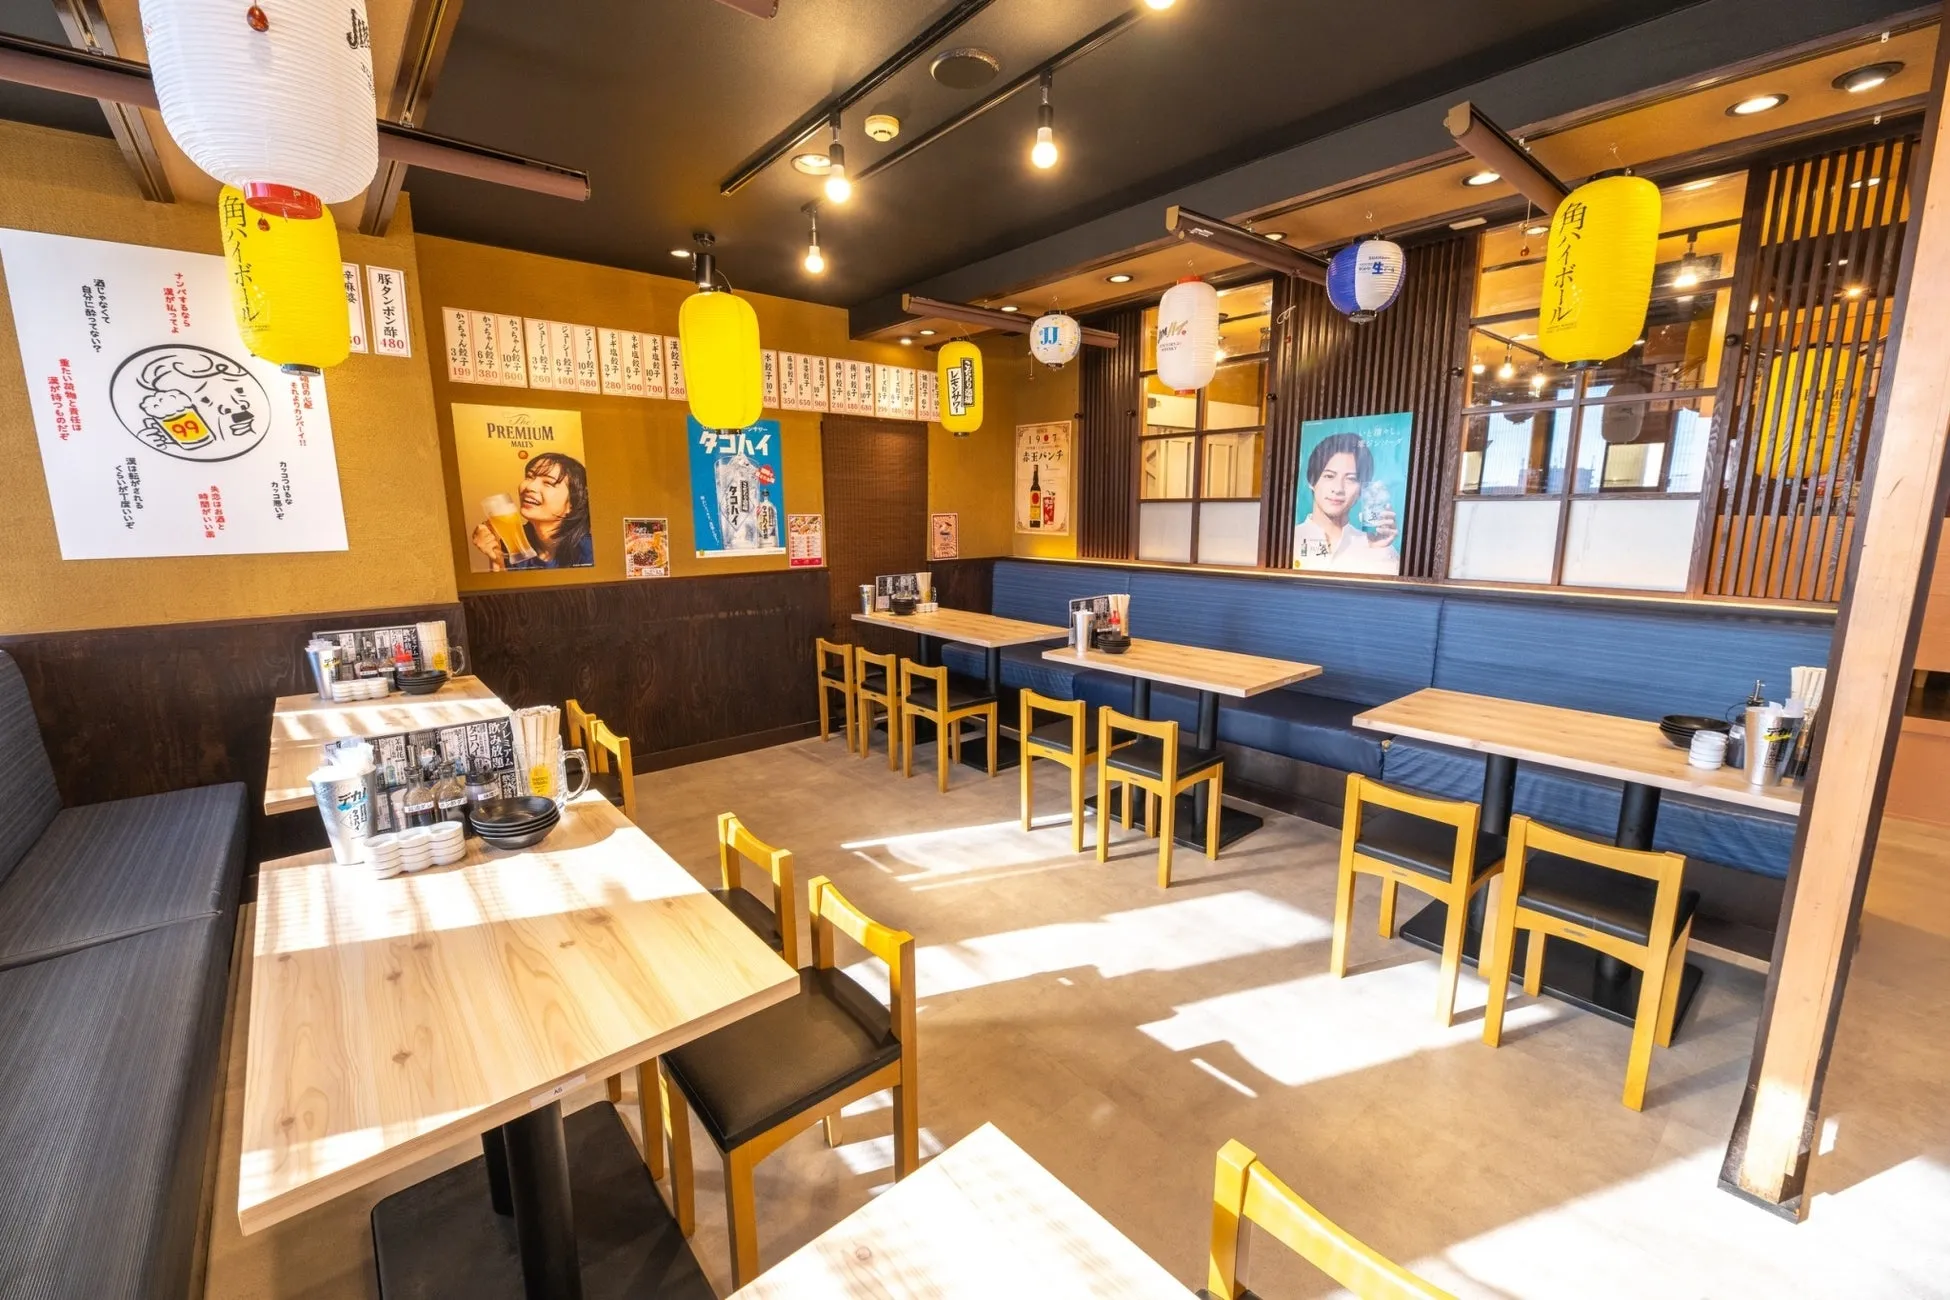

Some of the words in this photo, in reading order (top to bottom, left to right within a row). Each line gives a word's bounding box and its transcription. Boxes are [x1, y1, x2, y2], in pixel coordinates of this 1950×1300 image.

[224, 196, 260, 321] 角ハイボール
[1372, 261, 1384, 275] 生
[1551, 202, 1587, 324] 角ハイボール
[93, 278, 111, 324] 酒じゃなくて
[175, 272, 191, 328] ナンパするなら
[378, 272, 398, 338] 豚タンポン酢
[380, 338, 404, 349] 480
[456, 312, 469, 366] かっちゃん餃子
[483, 316, 495, 369] かっちゃん餃子
[509, 319, 521, 371] かっちゃん餃子
[610, 332, 619, 374] ネギ塩餃子
[631, 334, 641, 376] ネギ塩餃子
[652, 337, 661, 378] ネギ塩餃子
[479, 370, 498, 379] 380
[627, 383, 642, 391] 500
[765, 353, 773, 380] 水餃子
[647, 385, 663, 393] 700
[669, 387, 685, 395] 280
[951, 371, 961, 413] レモンサワー
[486, 422, 554, 441] PREMIUM
[699, 431, 772, 456] タコハイ
[1022, 449, 1064, 463] 赤玉パンチ
[729, 485, 739, 526] タコハイ
[488, 722, 504, 769] 飲み放題
[501, 720, 514, 766] プレミアム
